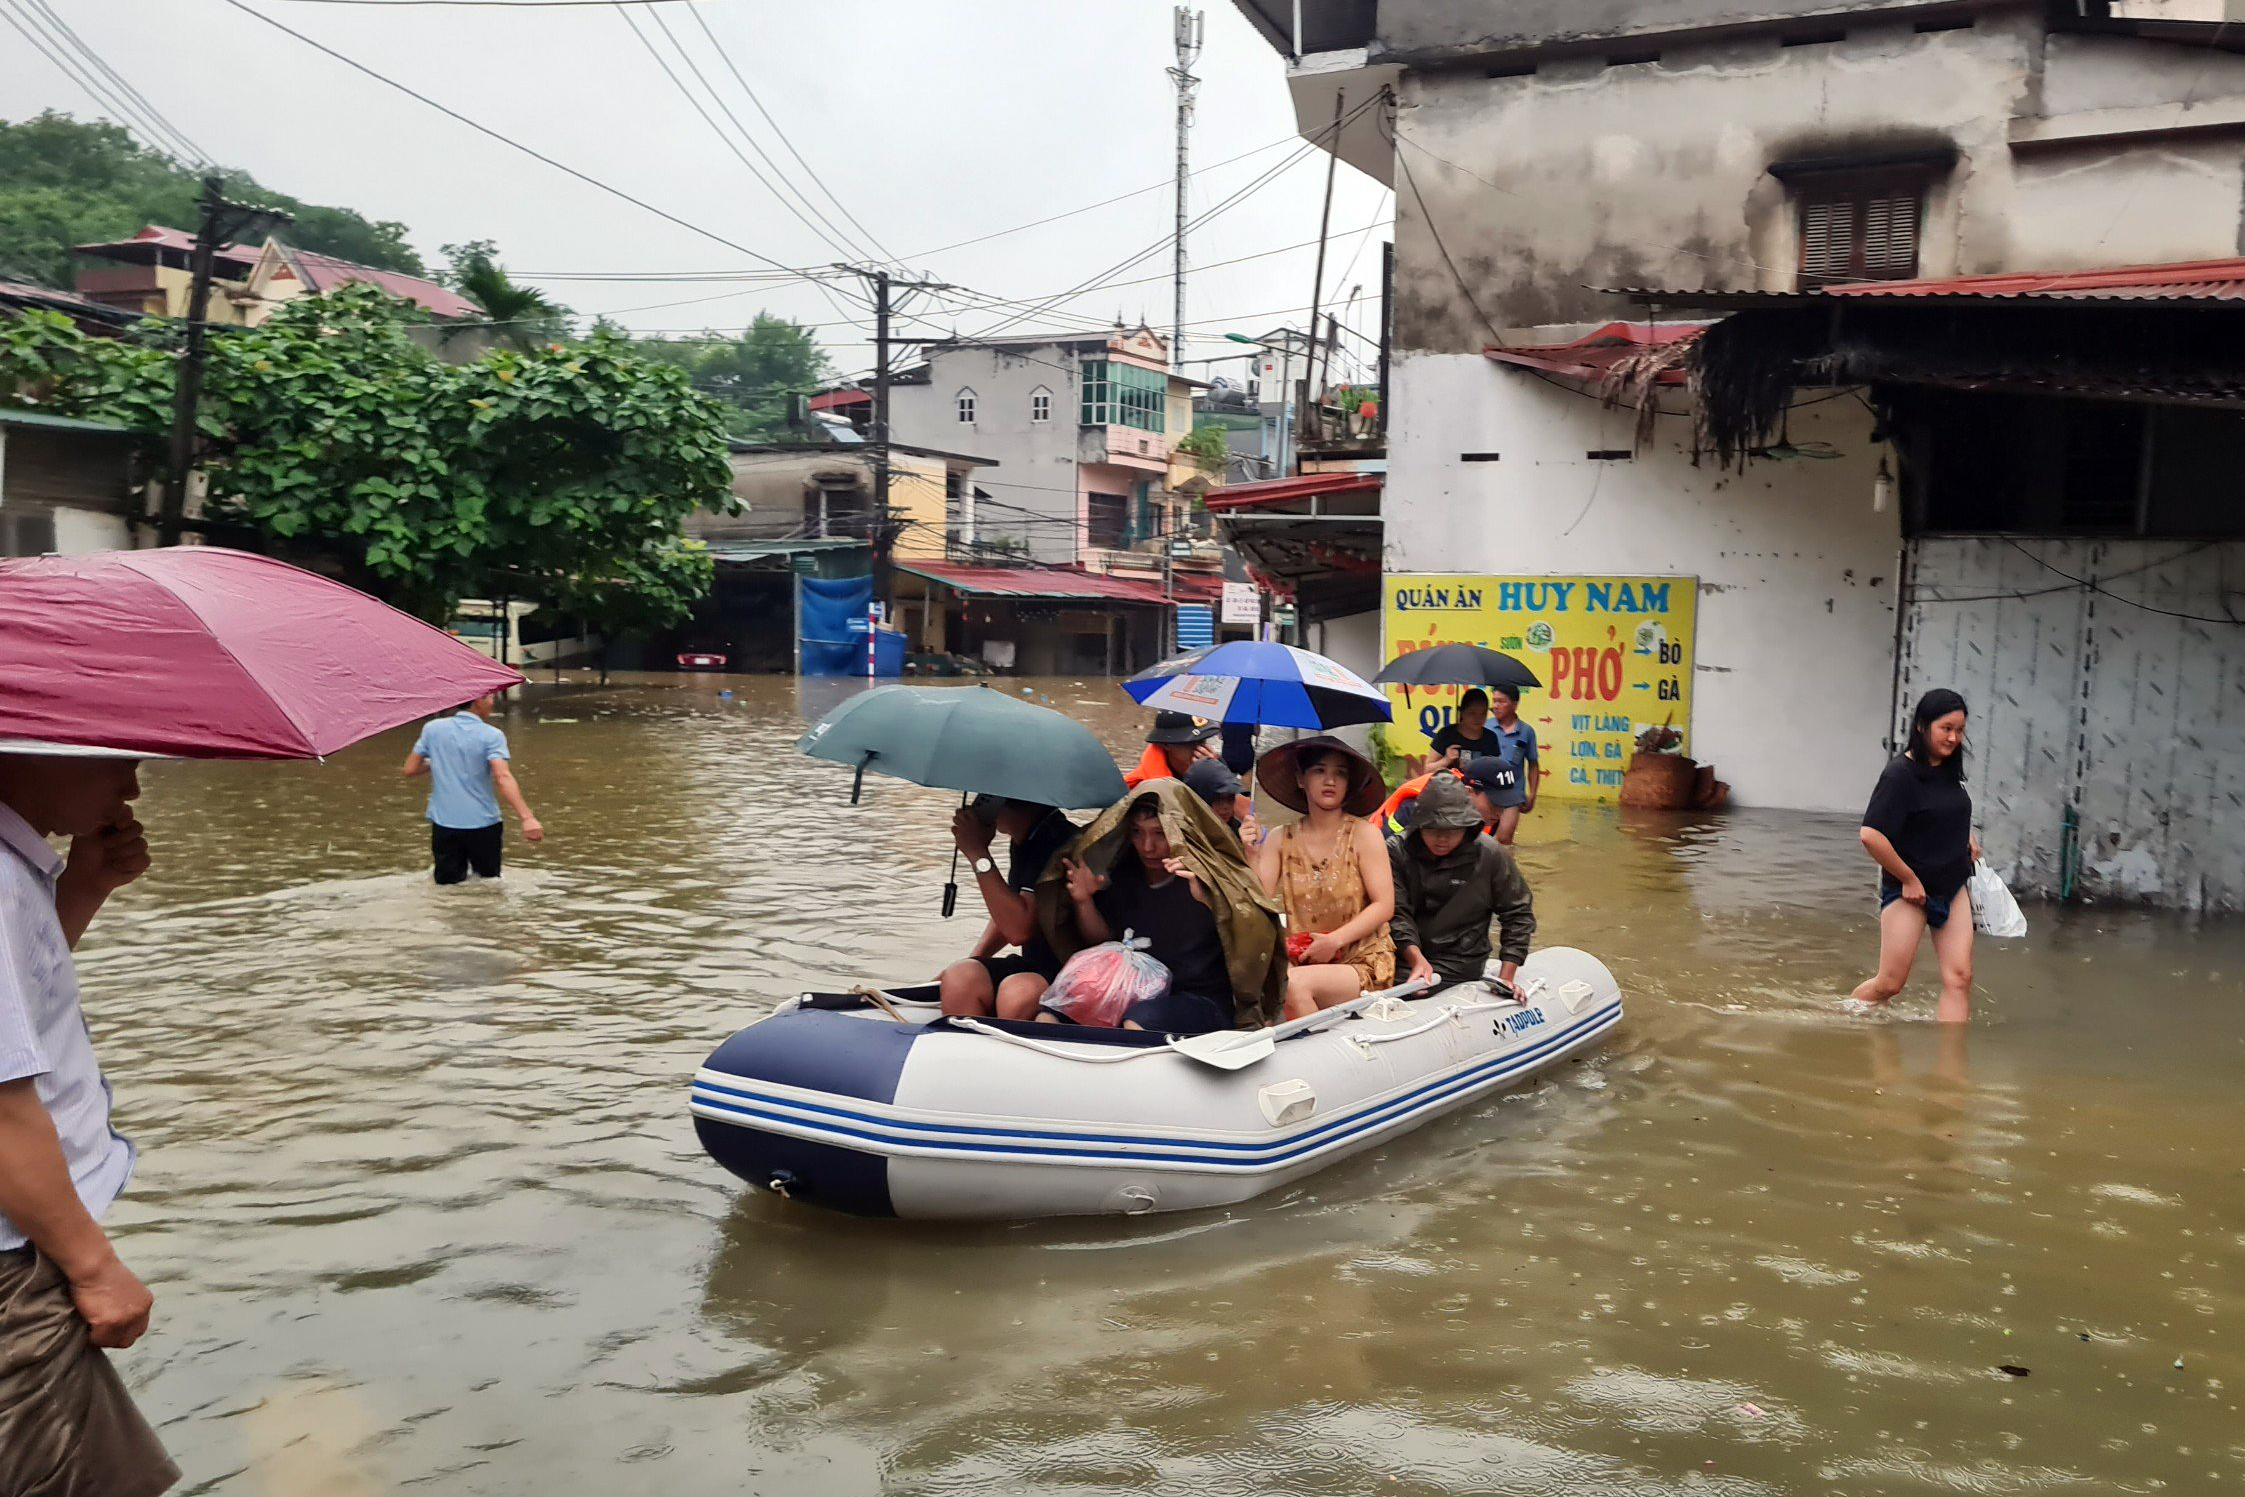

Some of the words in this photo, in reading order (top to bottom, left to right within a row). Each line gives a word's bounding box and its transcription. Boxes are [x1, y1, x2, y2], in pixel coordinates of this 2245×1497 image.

[1396, 584, 1449, 611] QUÁN
[1454, 584, 1482, 608] ĂN
[1498, 582, 1575, 611] HUY
[1586, 582, 1670, 612] NAM
[1549, 624, 1626, 701] PHỞ
[1658, 637, 1681, 664] BÒ
[1658, 675, 1680, 701] GÀ
